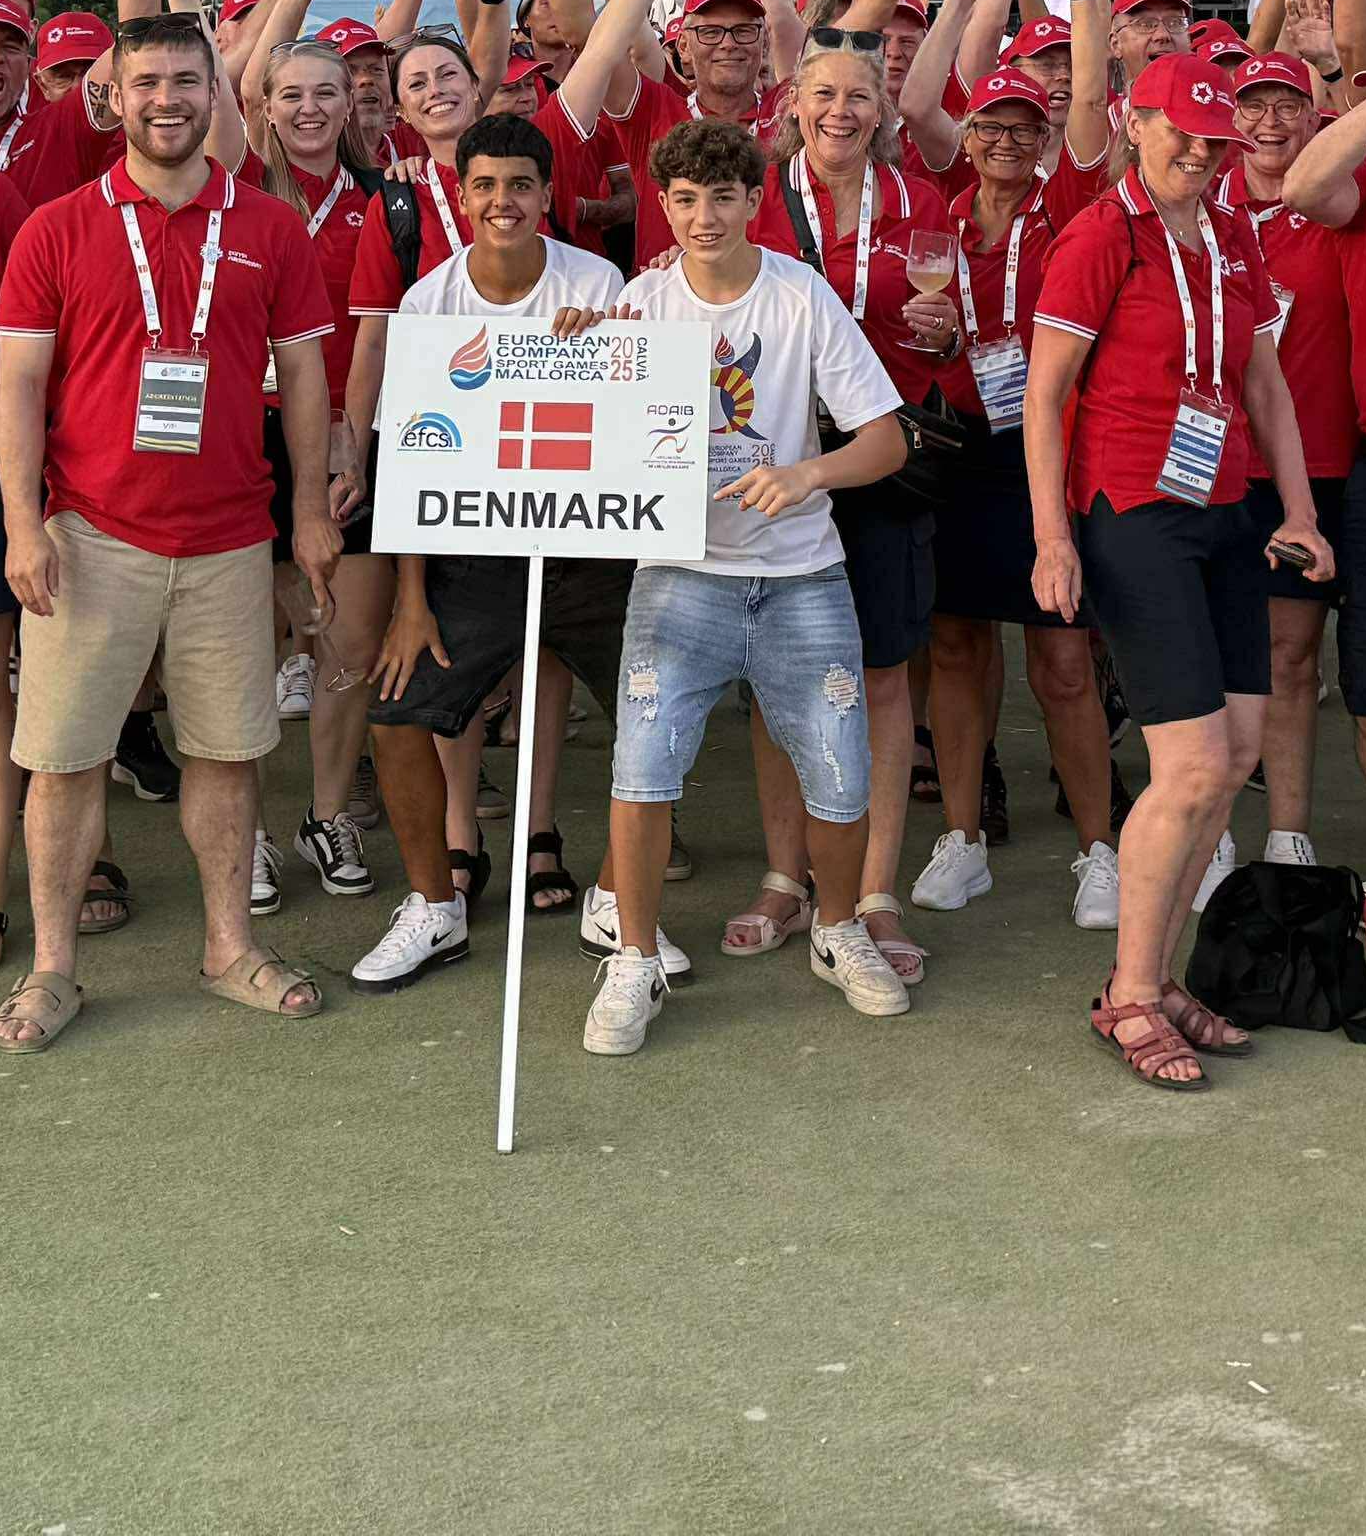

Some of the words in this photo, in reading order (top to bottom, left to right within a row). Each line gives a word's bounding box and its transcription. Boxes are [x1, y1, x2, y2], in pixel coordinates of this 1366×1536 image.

[497, 334, 611, 348] EUROPEAN
[610, 336, 634, 359] 20
[496, 346, 600, 360] COMPANY
[495, 359, 549, 369] SPORT
[553, 360, 609, 370] GAMES
[609, 359, 633, 382] 25
[495, 368, 604, 381] MALLORCA
[646, 404, 695, 416] ADAIB
[404, 426, 449, 448] efcs
[751, 443, 770, 458] 20
[416, 489, 666, 532] DENMARK
